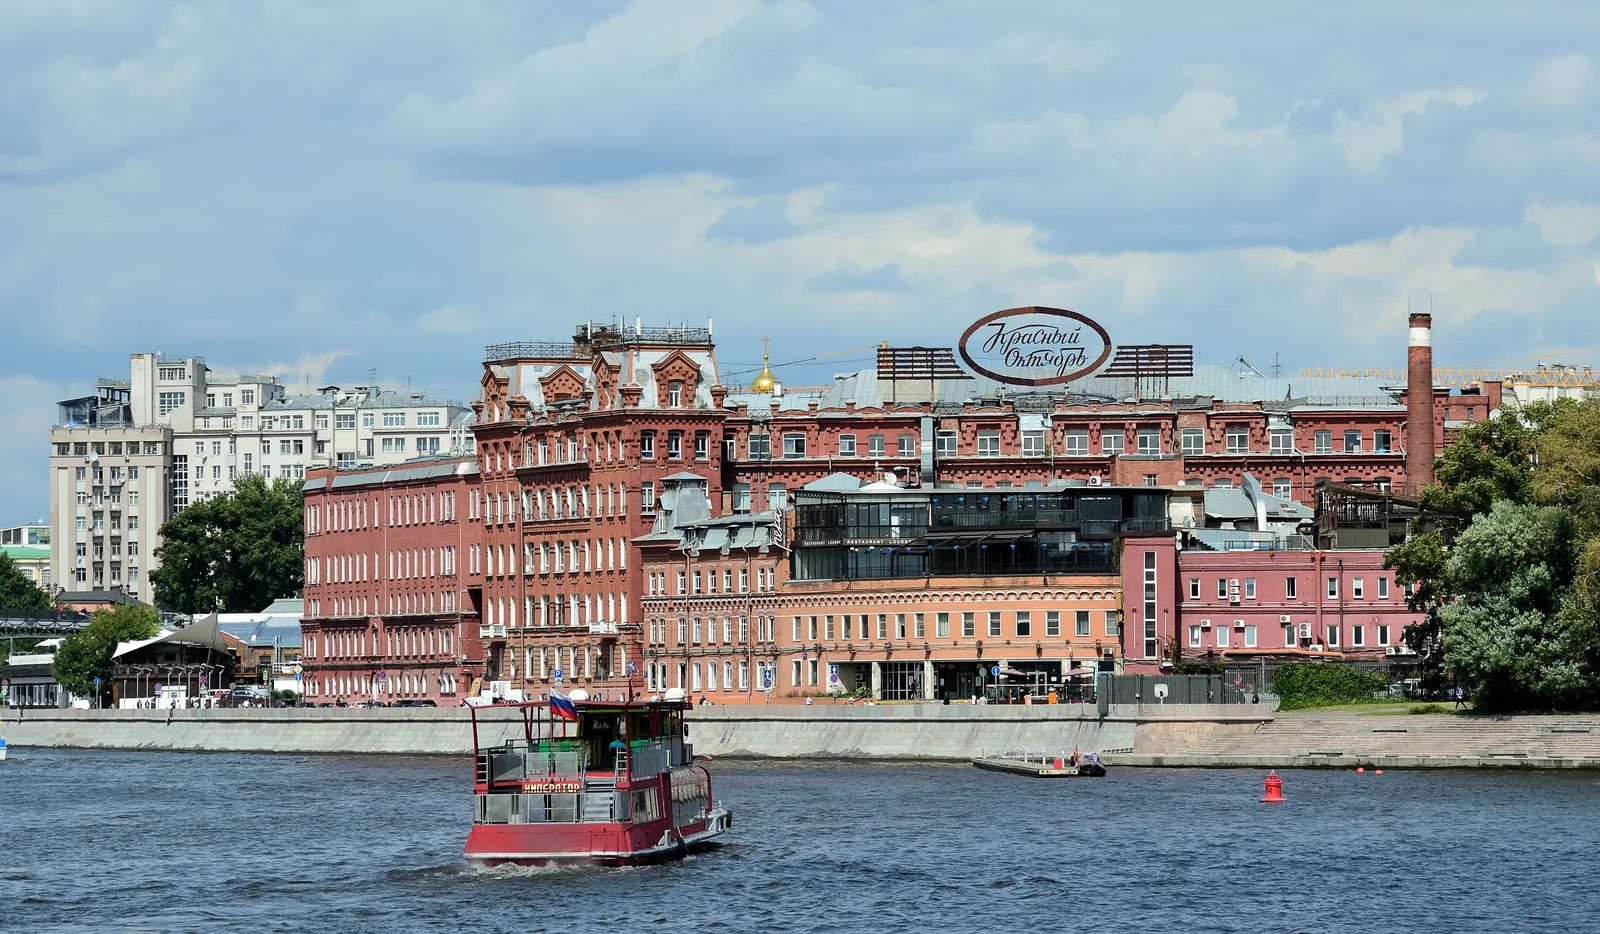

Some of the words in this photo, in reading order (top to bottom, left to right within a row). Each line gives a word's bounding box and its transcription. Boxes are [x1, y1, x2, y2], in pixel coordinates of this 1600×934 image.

[982, 322, 1082, 355] Красный
[1004, 347, 1089, 377] Октябрь
[524, 783, 580, 794] ИМПЕРАТОР
